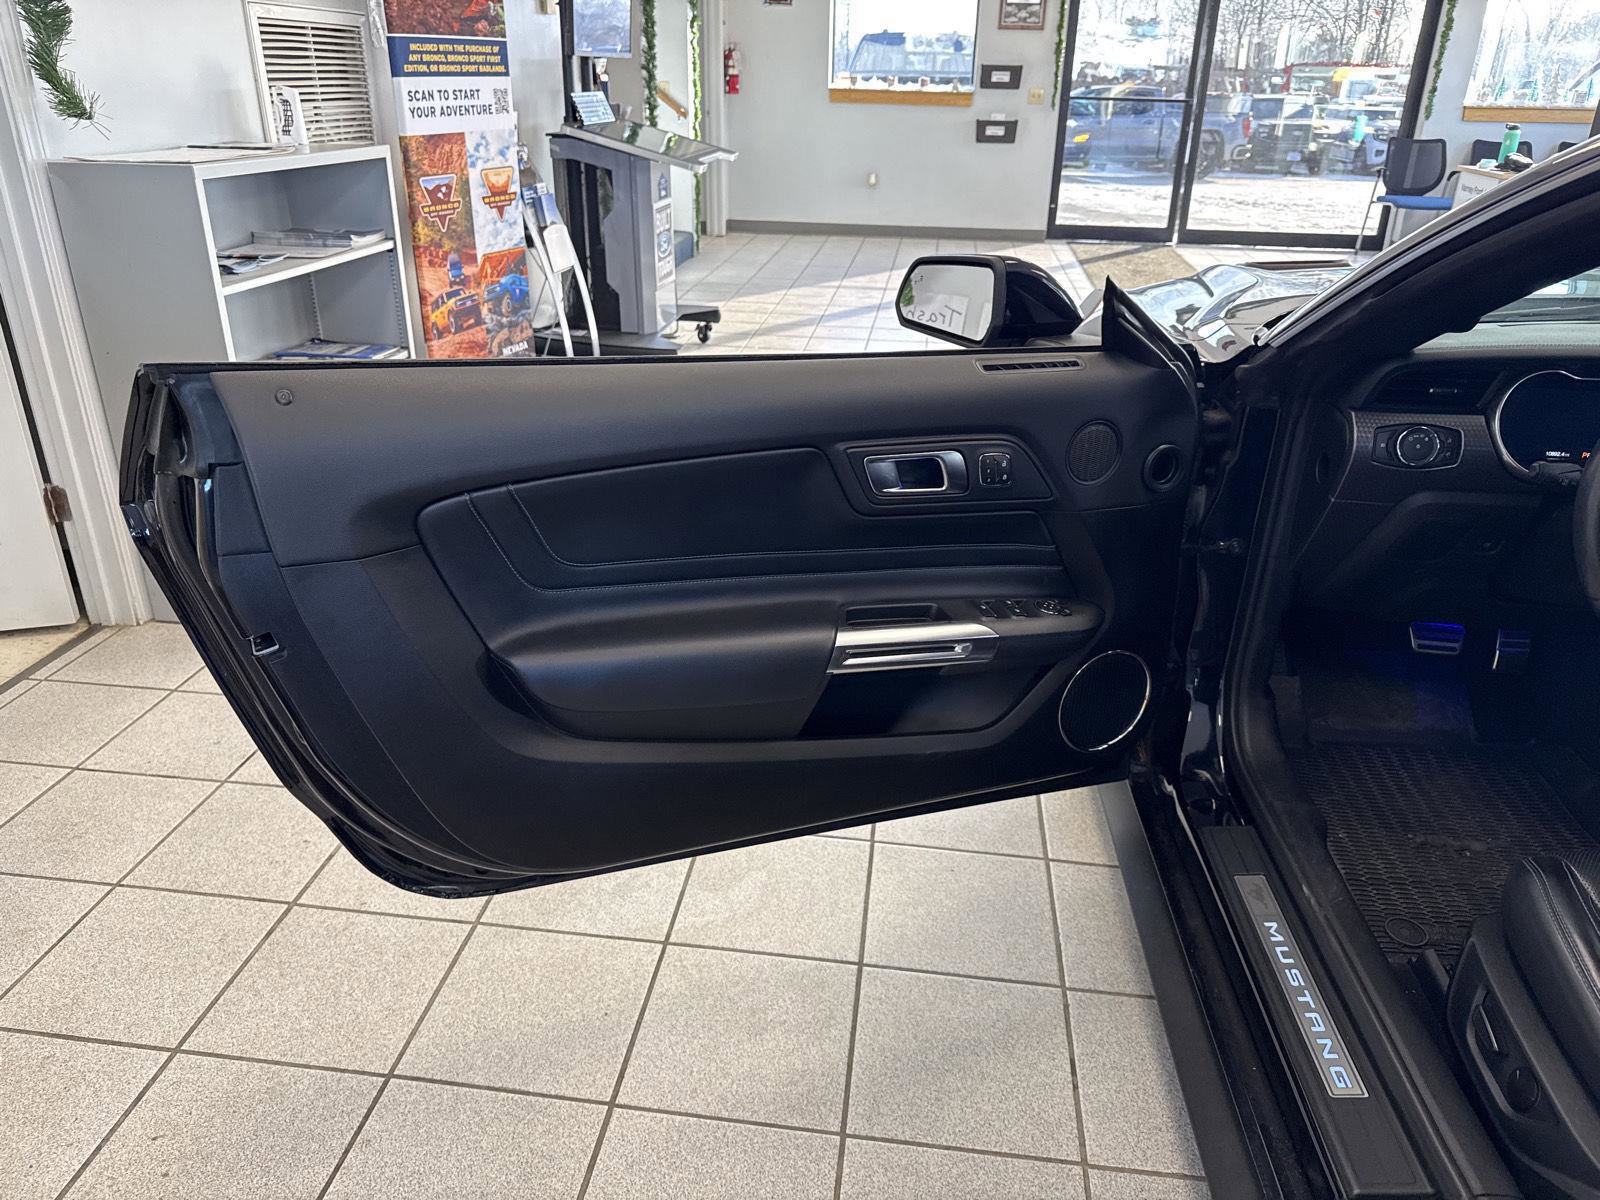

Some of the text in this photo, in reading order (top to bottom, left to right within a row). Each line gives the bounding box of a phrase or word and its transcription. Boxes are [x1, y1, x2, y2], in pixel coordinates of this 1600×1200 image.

[409, 43, 500, 53] INCLUDED WITH THE PURCHASE OF
[408, 54, 421, 62] ANY
[447, 55, 469, 63] BRONCO
[469, 55, 486, 63] SPORT
[487, 55, 500, 63] FIRST
[403, 64, 429, 73] EDITION,
[407, 88, 480, 102] SCAN TO START
[408, 104, 493, 118] YOUR ADVENTURE
[484, 193, 516, 203] BRONCO
[423, 202, 460, 213] BRONCO
[502, 340, 529, 357] NEVADA
[1263, 921, 1353, 1089] MUSTANG
